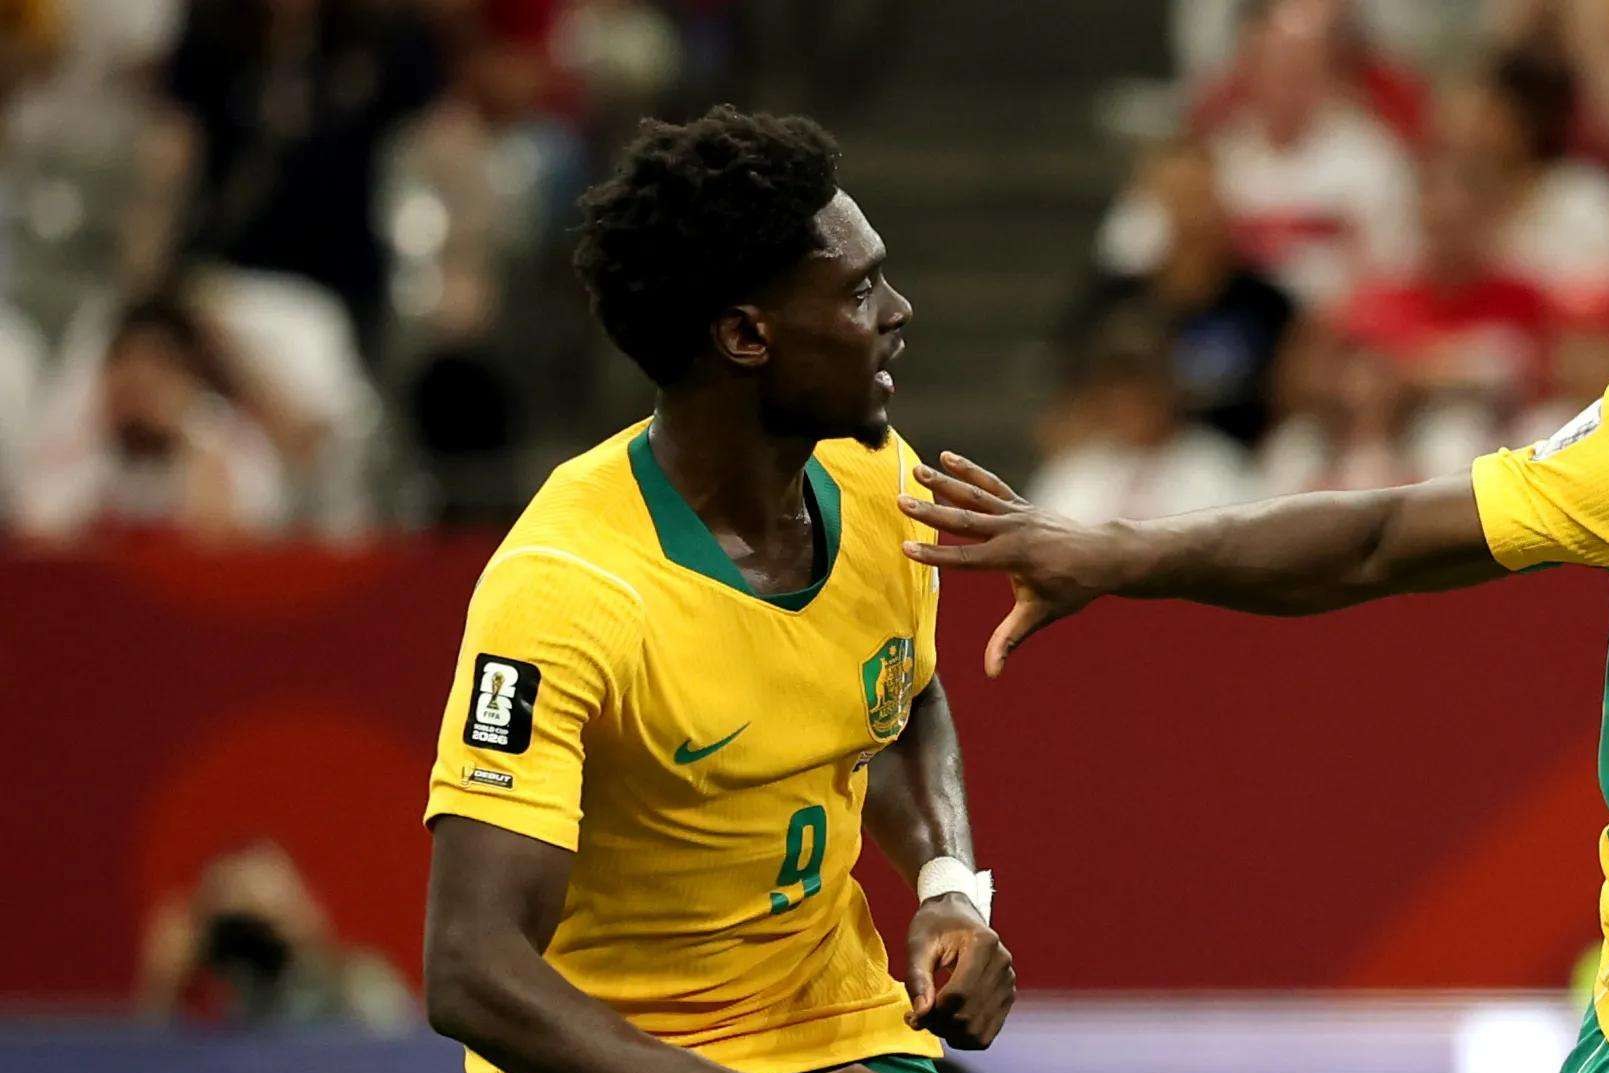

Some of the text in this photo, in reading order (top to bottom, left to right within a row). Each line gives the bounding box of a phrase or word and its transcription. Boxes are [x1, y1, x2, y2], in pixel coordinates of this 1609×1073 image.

[483, 710, 500, 720] FIFA
[472, 730, 508, 745] 2026
[770, 804, 827, 915] 9
